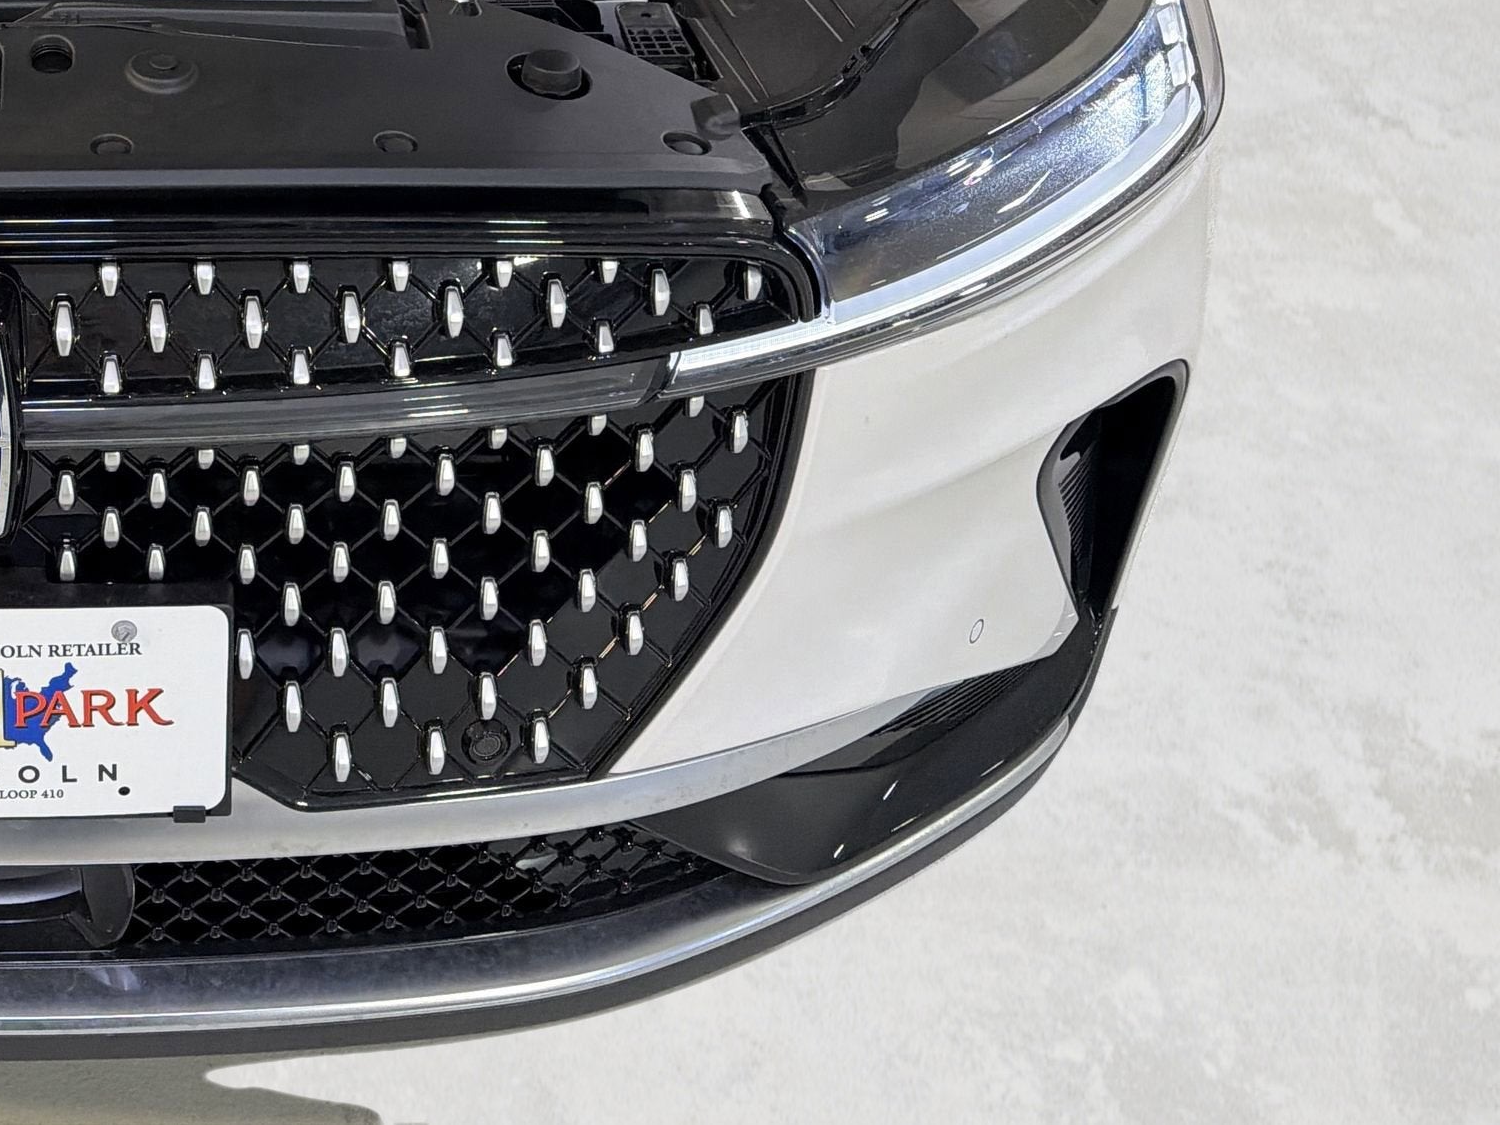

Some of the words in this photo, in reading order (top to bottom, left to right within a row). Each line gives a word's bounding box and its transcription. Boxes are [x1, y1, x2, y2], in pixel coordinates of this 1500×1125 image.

[49, 642, 142, 658] RETAILER
[13, 687, 175, 728] PARK
[0, 789, 38, 800] LOOP
[41, 788, 64, 799] 410
